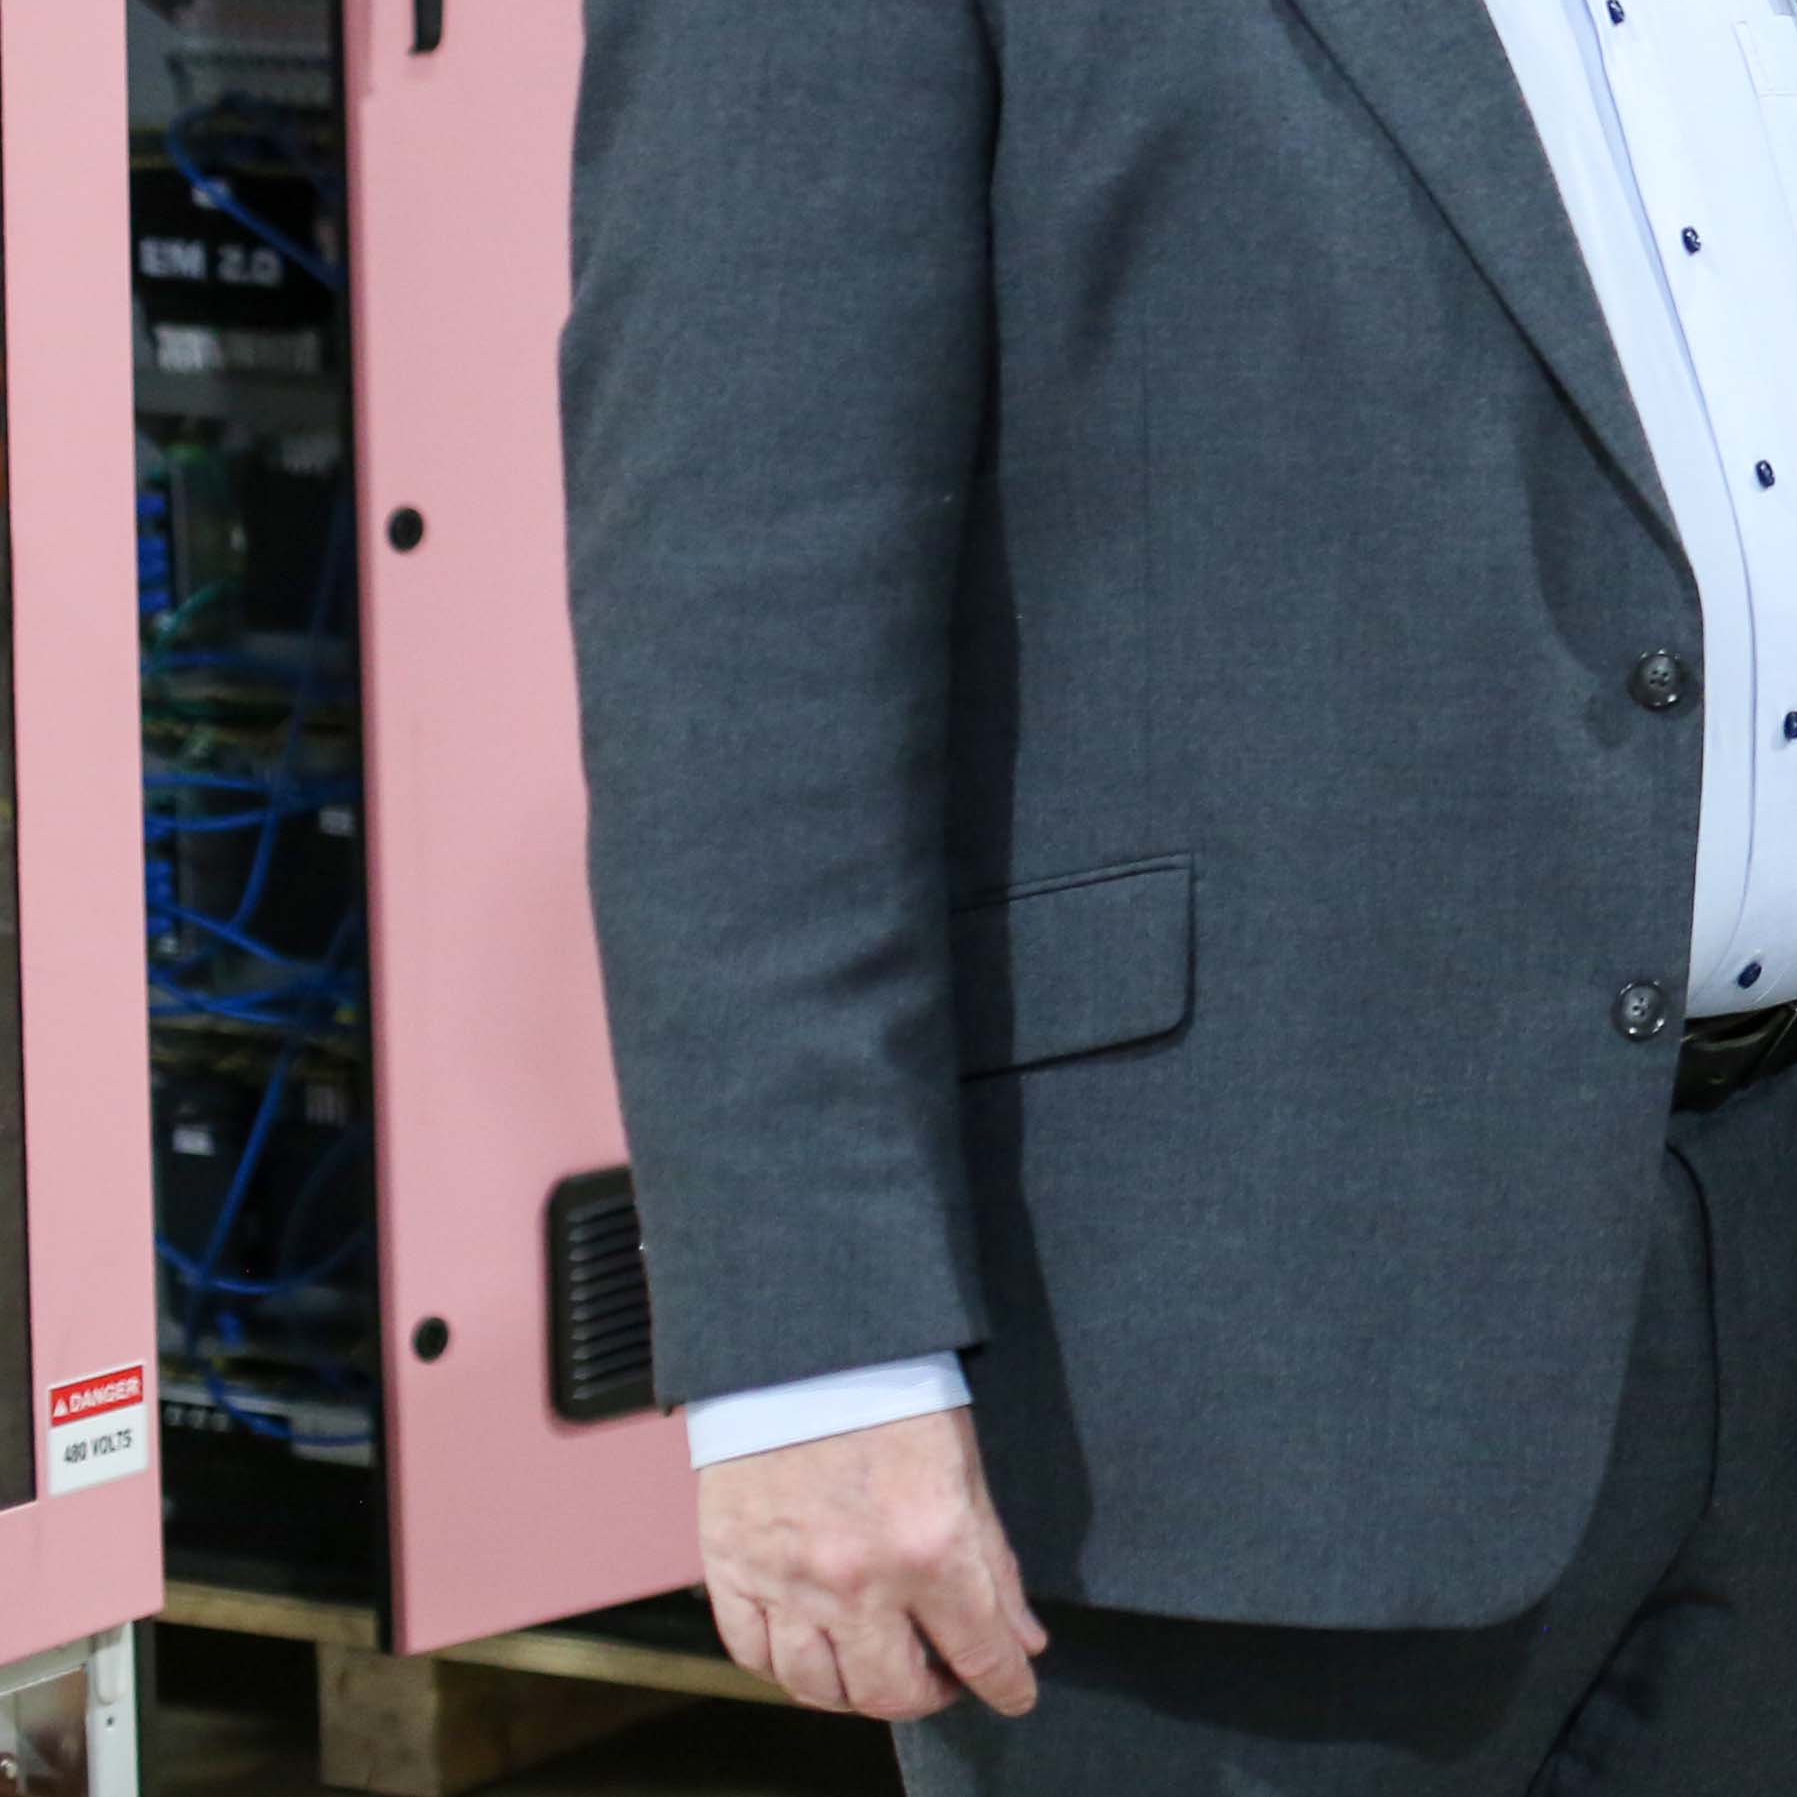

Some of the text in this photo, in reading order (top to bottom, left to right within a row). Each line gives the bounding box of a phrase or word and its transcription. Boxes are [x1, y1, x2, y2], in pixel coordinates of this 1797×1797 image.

[69, 1377, 140, 1413] DANGER
[64, 1428, 133, 1464] 480 VOLTS
